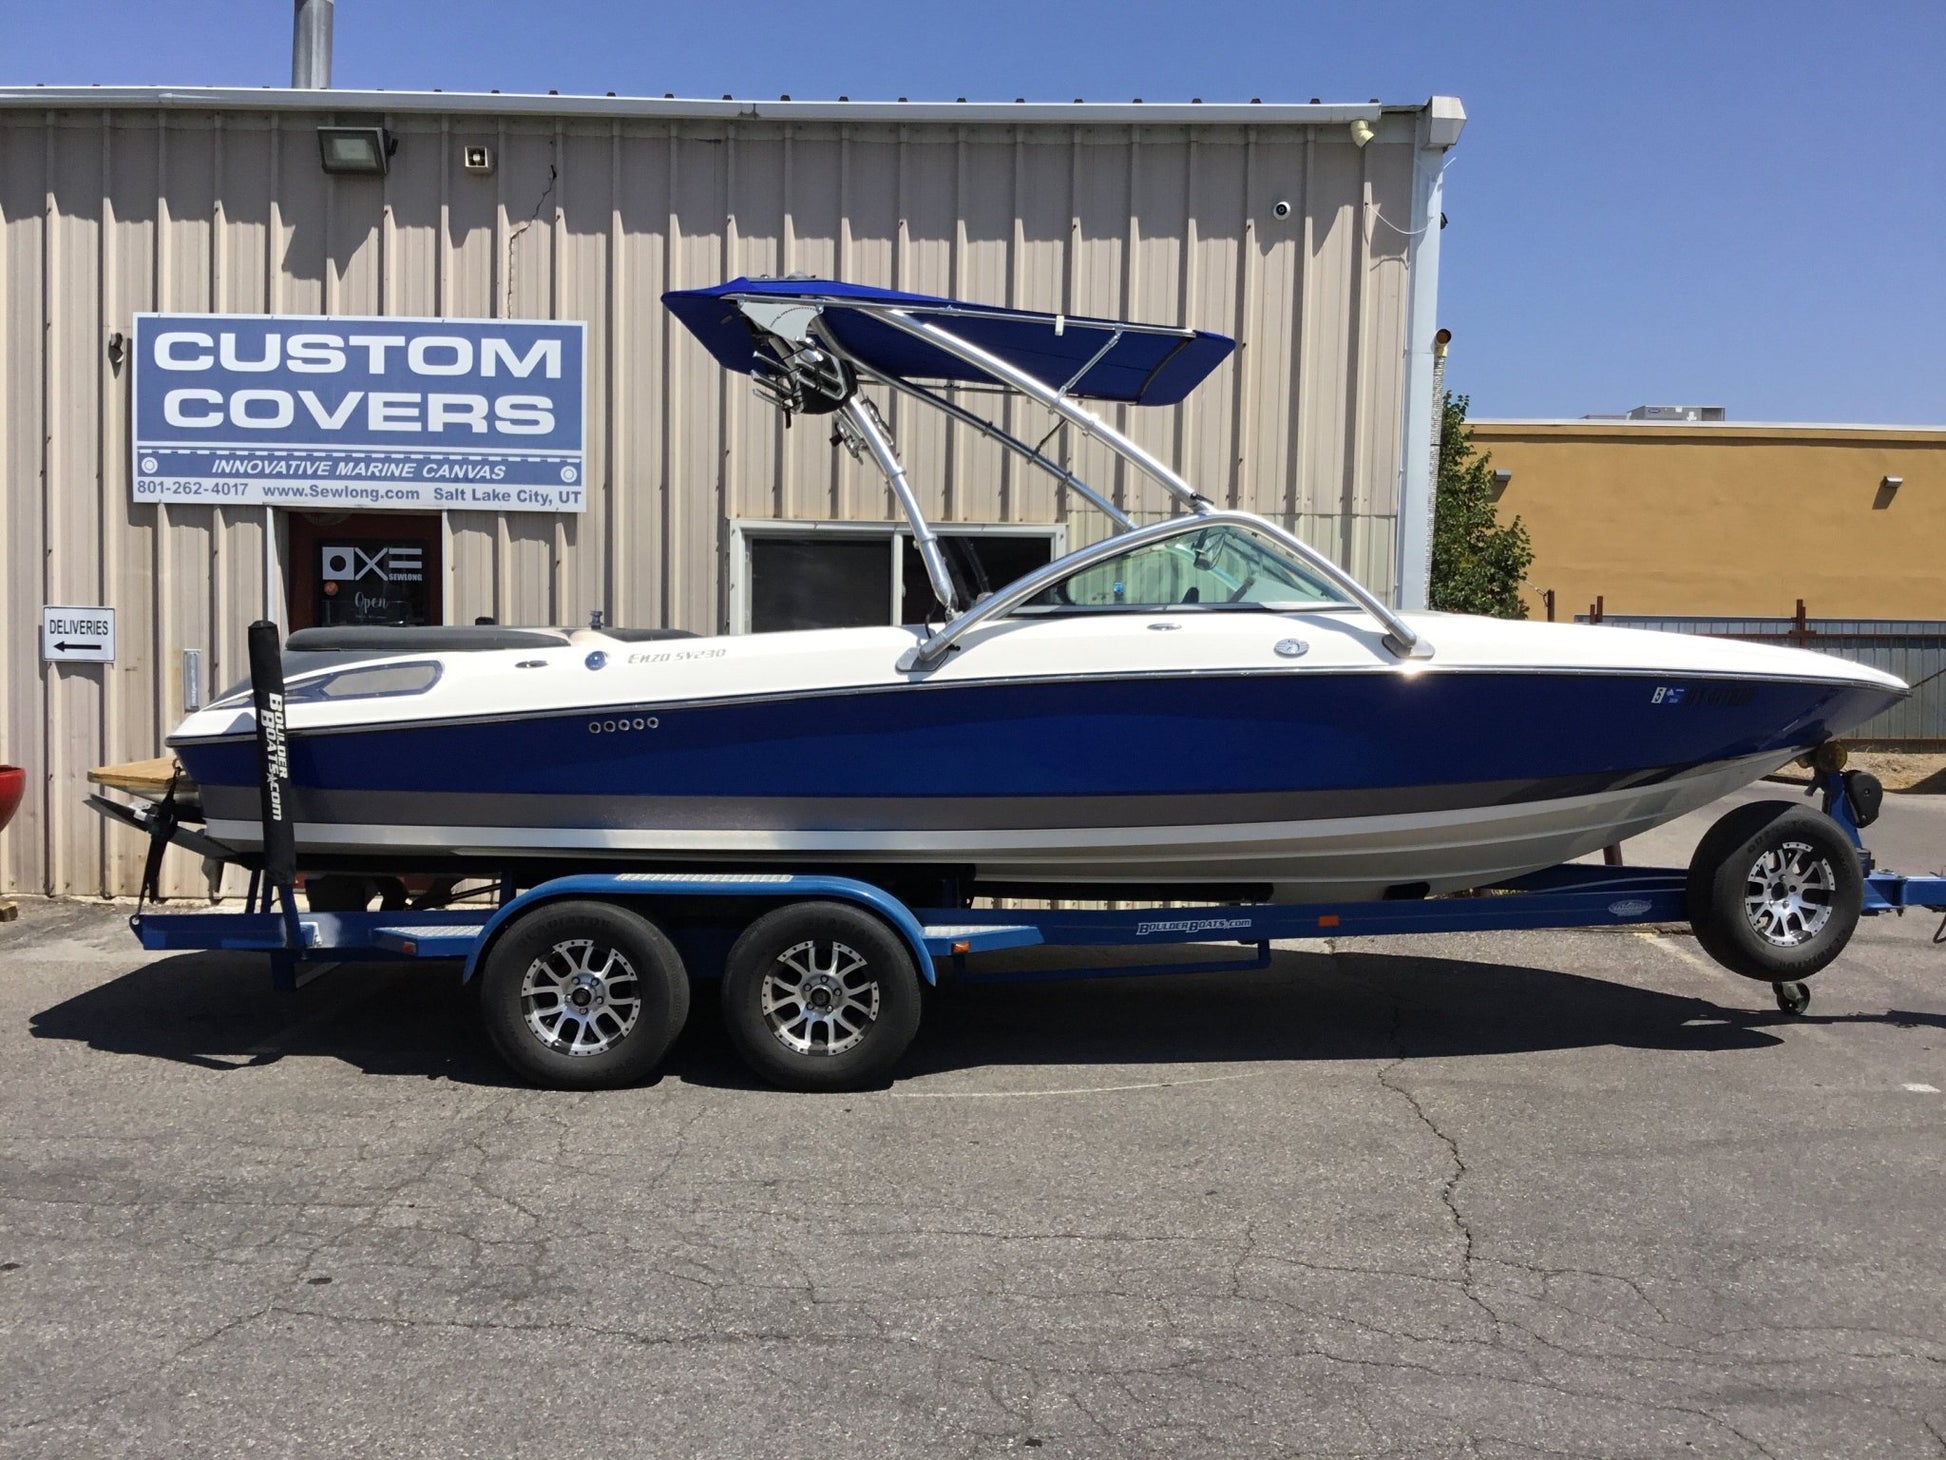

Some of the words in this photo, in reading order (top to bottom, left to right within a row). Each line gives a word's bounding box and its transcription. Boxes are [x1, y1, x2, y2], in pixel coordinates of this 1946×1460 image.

[154, 332, 561, 378] CUSTOM
[164, 389, 555, 434] COVERS
[212, 459, 332, 475] INNOVATIVE
[336, 462, 416, 477] MARINE
[422, 464, 506, 479] CANVAS
[137, 480, 249, 496] 801-262-4017
[262, 484, 420, 502] www.Sewlong.com
[433, 487, 466, 502] Salt
[472, 488, 511, 503] Lake
[516, 489, 553, 505] City,
[558, 490, 582, 504] UT
[388, 573, 423, 581] SEWLONG
[354, 591, 389, 615] Open
[49, 619, 109, 637] DELIVERIES
